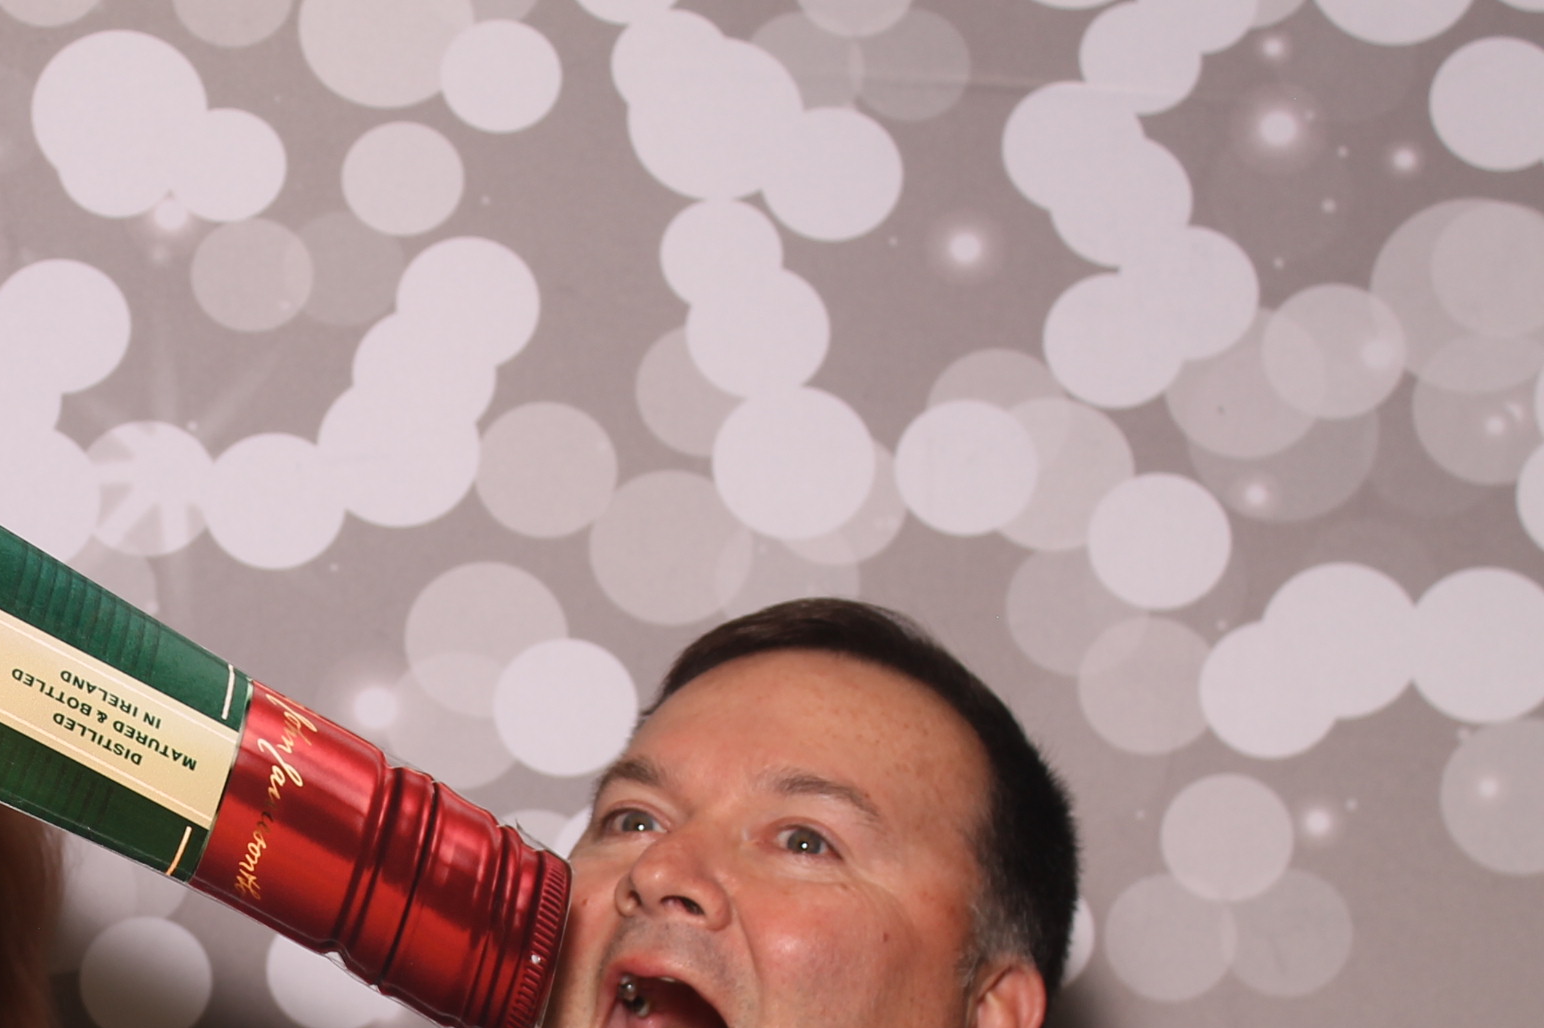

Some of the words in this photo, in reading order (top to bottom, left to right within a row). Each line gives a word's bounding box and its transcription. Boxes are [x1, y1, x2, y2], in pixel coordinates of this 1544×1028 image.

[11, 668, 92, 717] BOTTLED
[60, 670, 138, 717] IRELAND
[97, 709, 109, 724] &
[53, 712, 143, 766] DISTILLED
[143, 712, 162, 729] IN
[113, 720, 197, 771] MATURED
